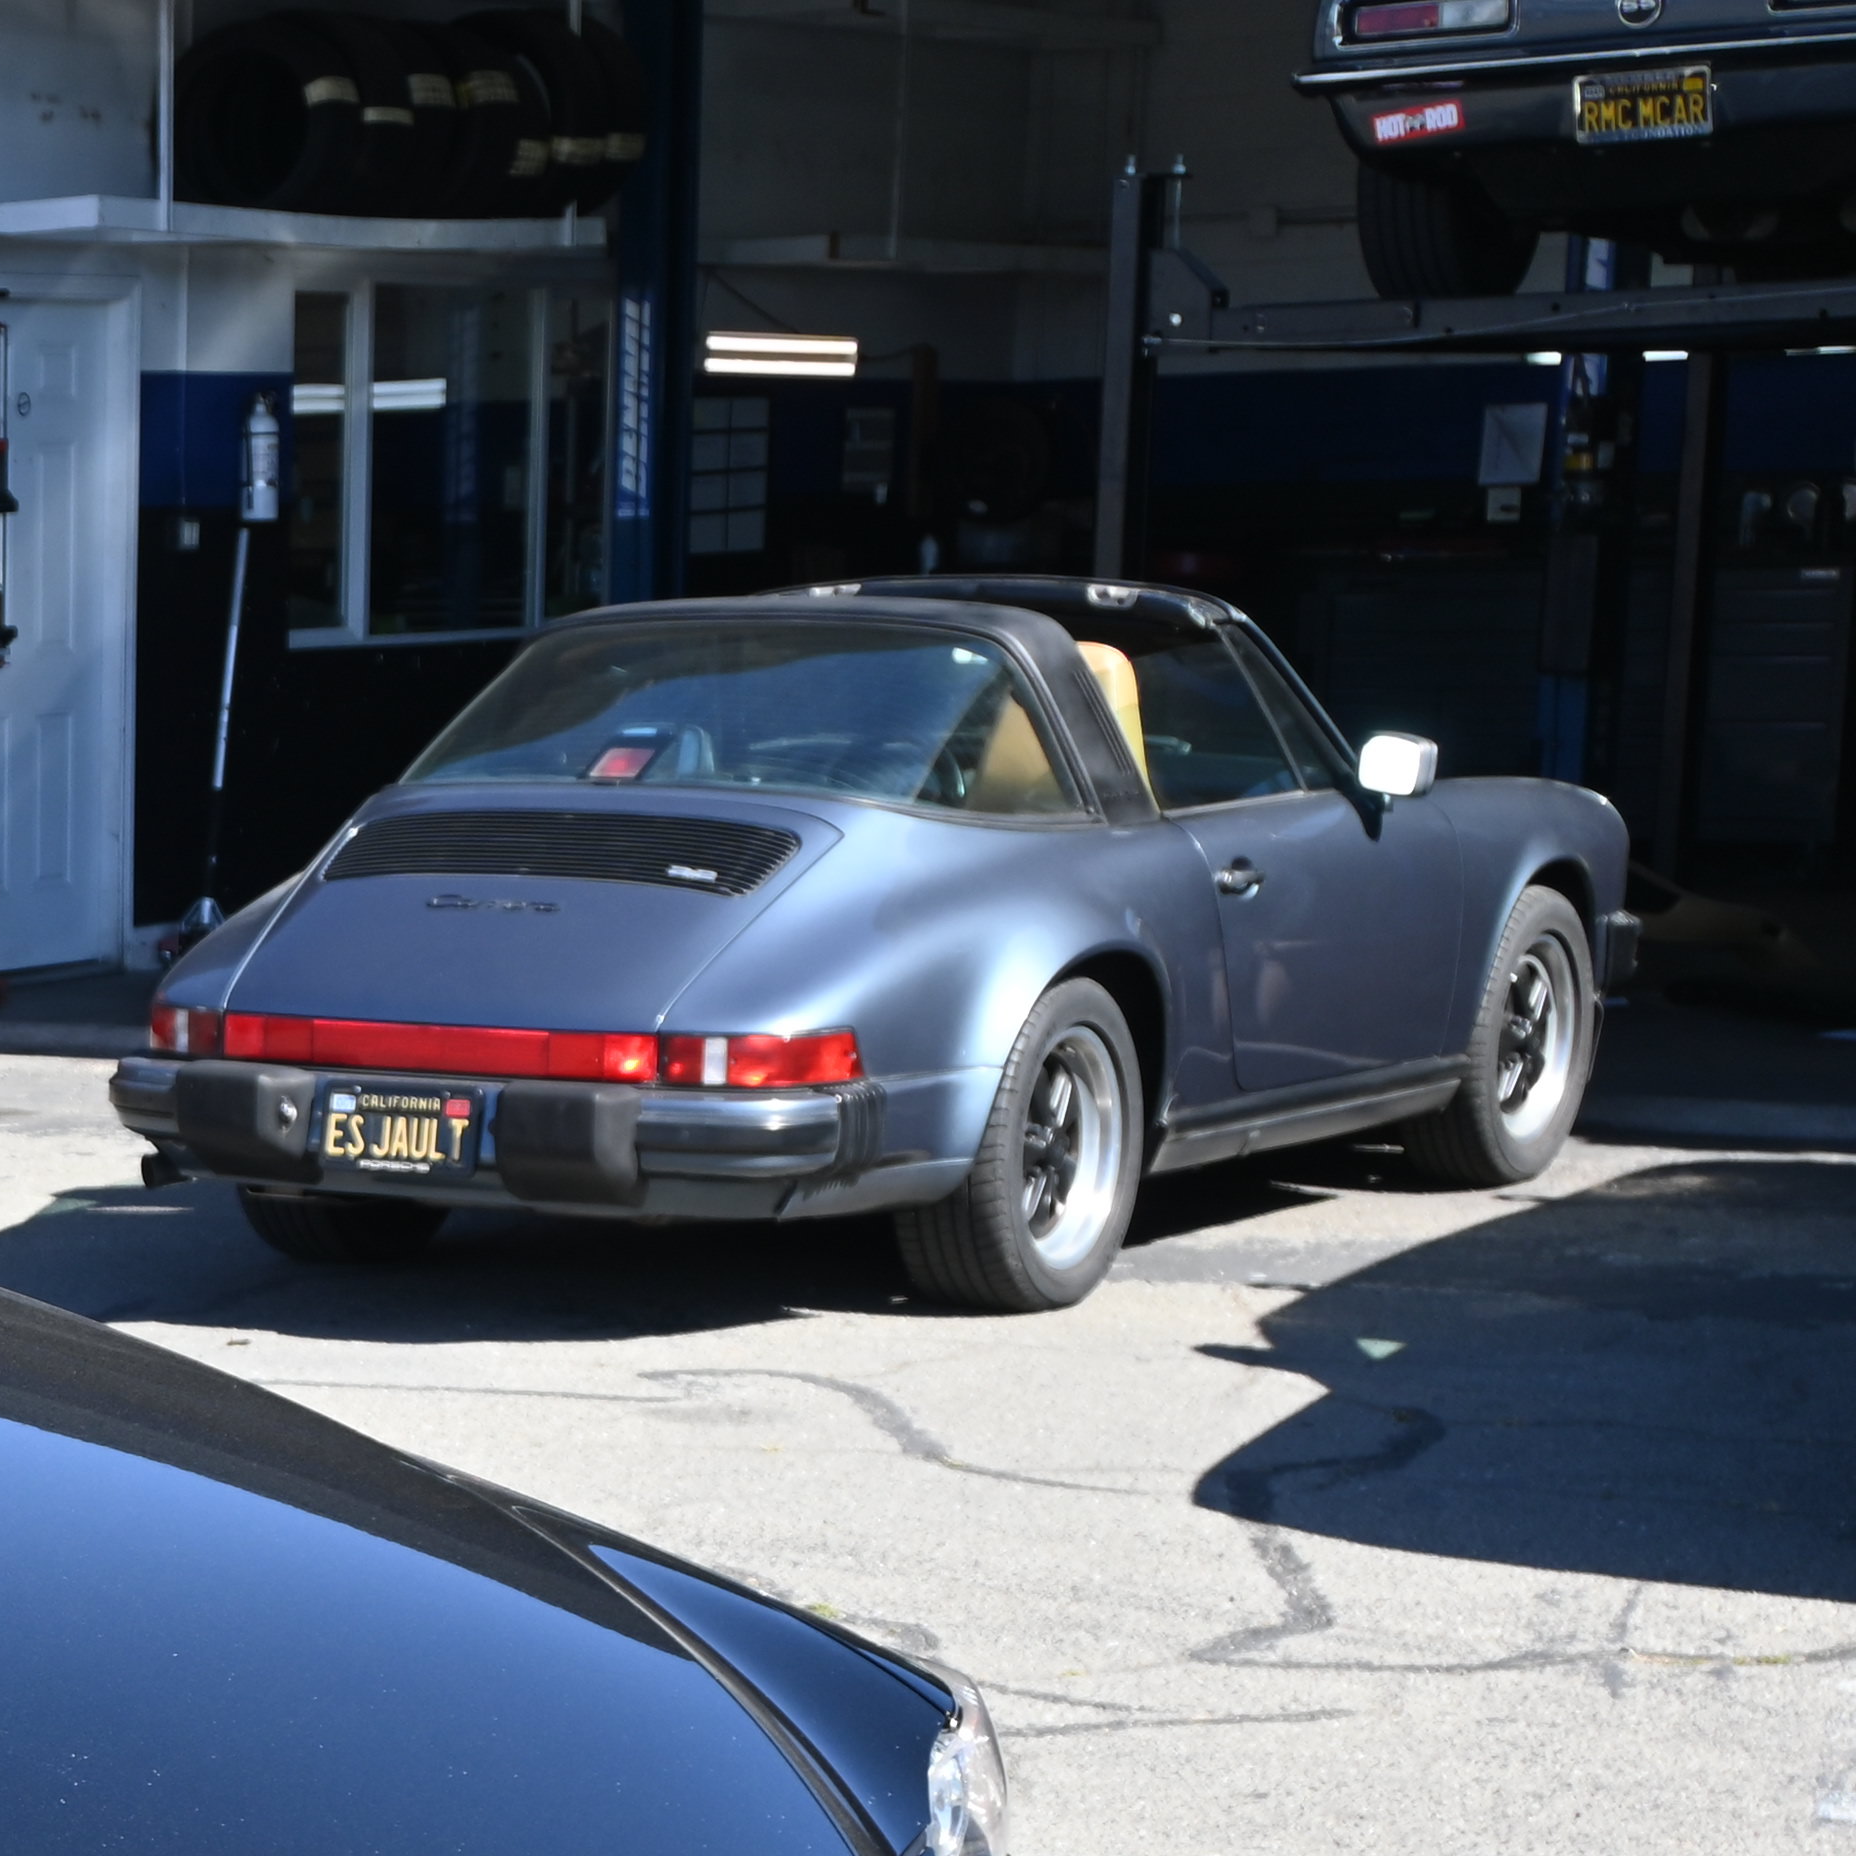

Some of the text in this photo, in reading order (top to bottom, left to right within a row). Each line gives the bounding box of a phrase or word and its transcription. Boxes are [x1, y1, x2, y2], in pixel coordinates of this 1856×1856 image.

[1374, 103, 1459, 142] HOT ROD
[1584, 93, 1705, 133] RMC MCAR
[361, 1094, 442, 1112] CALIFORNIA
[325, 1112, 365, 1158] ES
